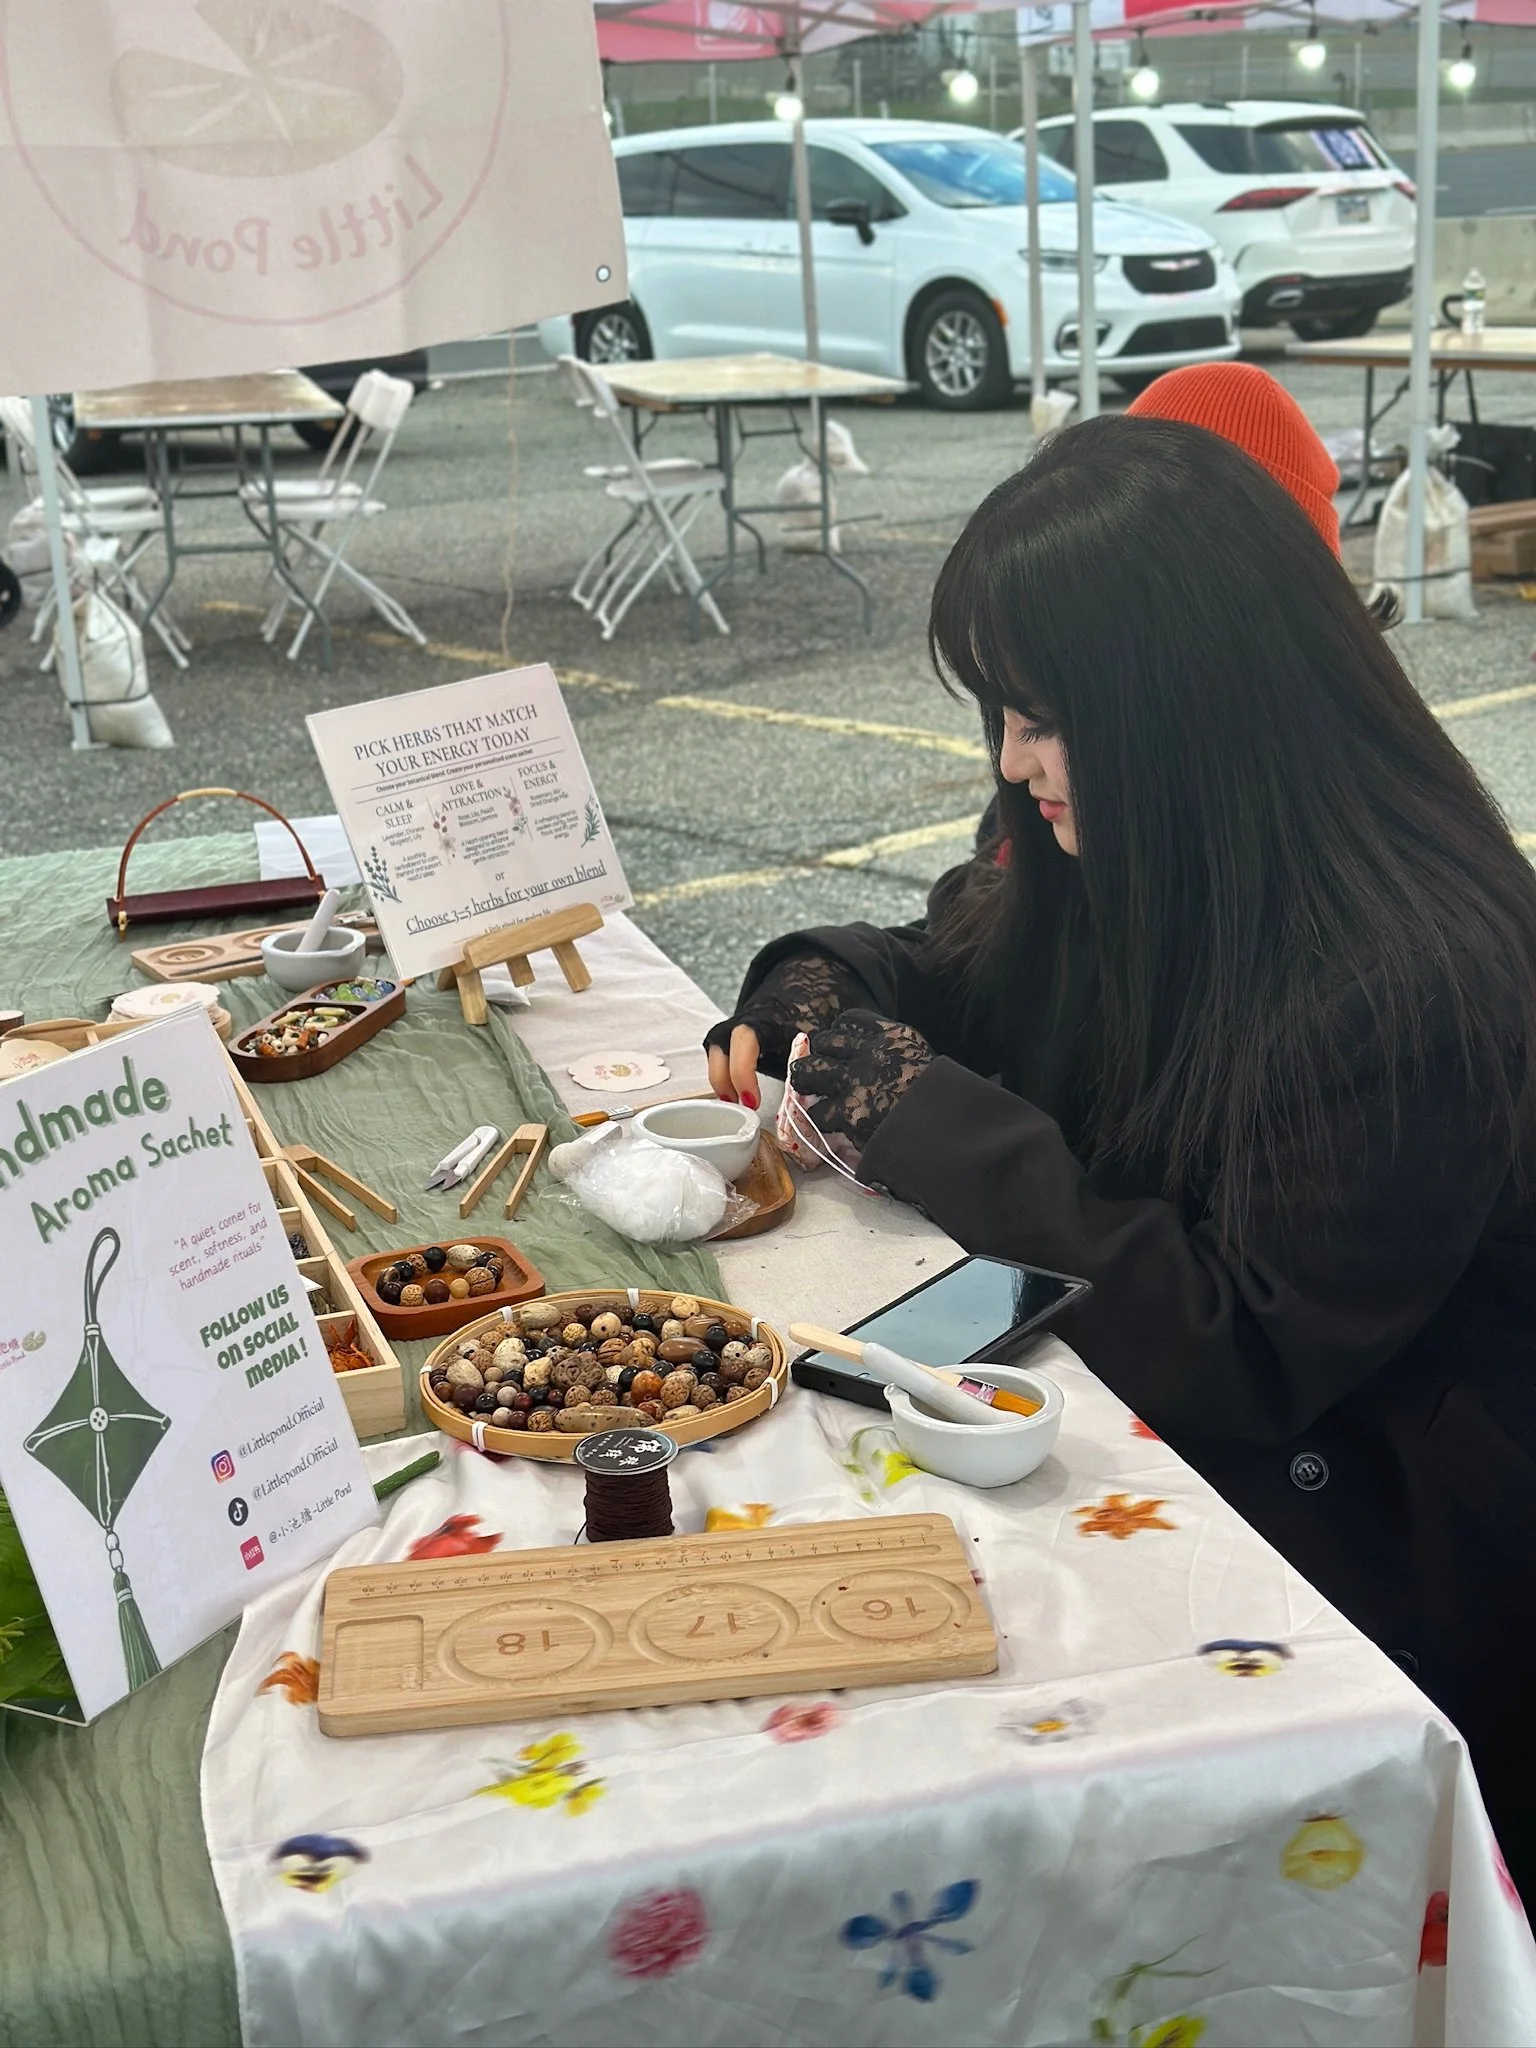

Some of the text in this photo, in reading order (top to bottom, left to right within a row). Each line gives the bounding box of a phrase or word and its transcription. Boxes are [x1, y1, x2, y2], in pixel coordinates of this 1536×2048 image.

[354, 705, 538, 760] PICK HERBS THAT MATCH
[376, 727, 531, 777] YOUR ENERGY TODAY
[518, 760, 556, 778] FOCUS &
[524, 772, 559, 790] ENERGY
[442, 787, 503, 812] ATTRACTION
[450, 779, 484, 796] LOVE &
[376, 799, 414, 816] CALM &
[385, 814, 412, 829] SLEEP
[496, 872, 505, 881] or
[406, 916, 450, 932] Choose
[472, 893, 503, 913] herbs
[505, 887, 523, 902] for
[524, 880, 550, 901] your
[551, 873, 574, 889] own
[574, 860, 606, 881] blend
[31, 1113, 234, 1244] Aroma Sachet
[191, 1226, 216, 1246] quiet
[218, 1209, 246, 1230] corner
[248, 1202, 261, 1215] for
[169, 1217, 268, 1276] scent, softness, and
[179, 1258, 231, 1290] handmade
[200, 1297, 266, 1348] FOLLOW
[238, 1397, 325, 1459] @Littlepond.Official
[252, 1437, 339, 1500] @Littlepond.Official
[861, 1596, 926, 1621] 16
[685, 1612, 746, 1640] 17
[495, 1629, 560, 1656] 18
